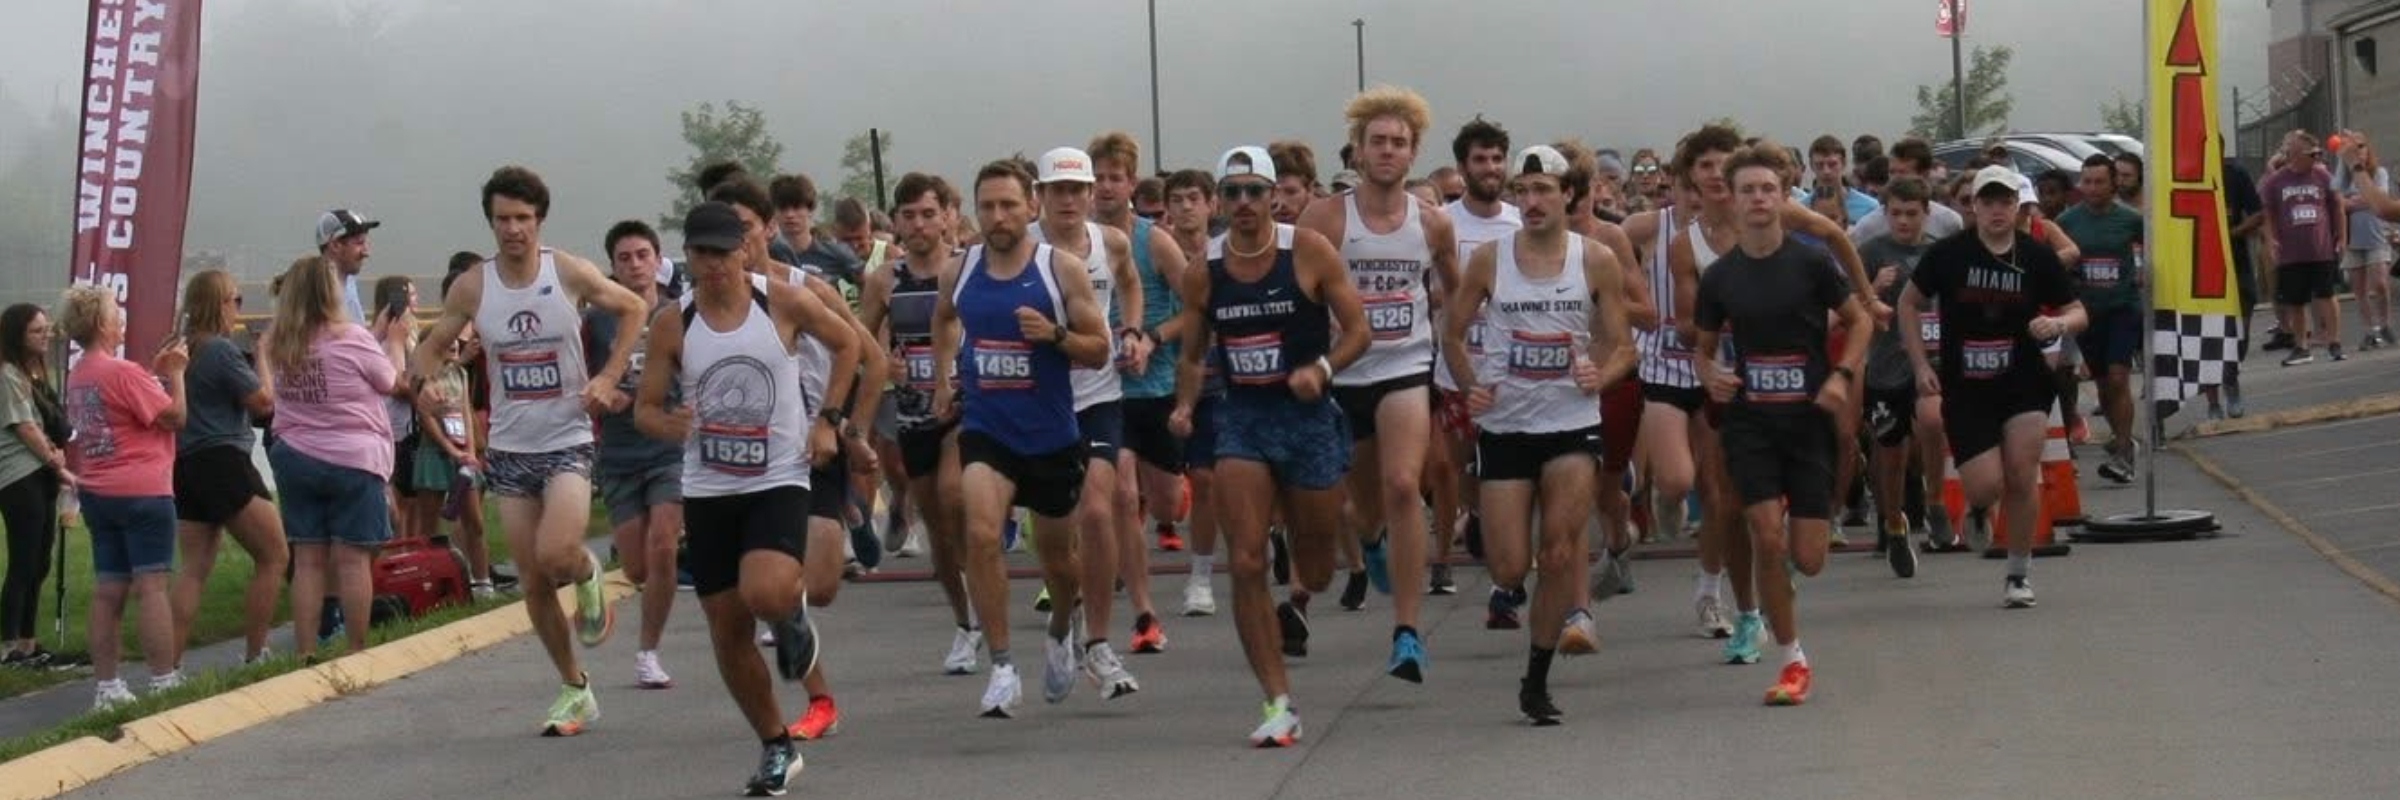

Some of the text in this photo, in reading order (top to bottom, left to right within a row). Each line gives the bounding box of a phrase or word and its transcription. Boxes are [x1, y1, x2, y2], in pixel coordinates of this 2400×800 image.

[78, 0, 123, 234] WINCHE
[106, 0, 165, 249] COUNTRY
[1348, 259, 1421, 272] WINCHESTER
[1967, 267, 2022, 292] MIAMI
[1263, 300, 1295, 316] STATE
[1553, 300, 1583, 312] STATE
[975, 354, 1030, 378] 1495
[1228, 347, 1280, 373] 1537
[1513, 345, 1568, 368] 1528
[1964, 351, 2010, 369] 1451
[503, 365, 558, 389] 1480
[1748, 367, 1805, 390] 1539
[702, 437, 767, 465] 1529
